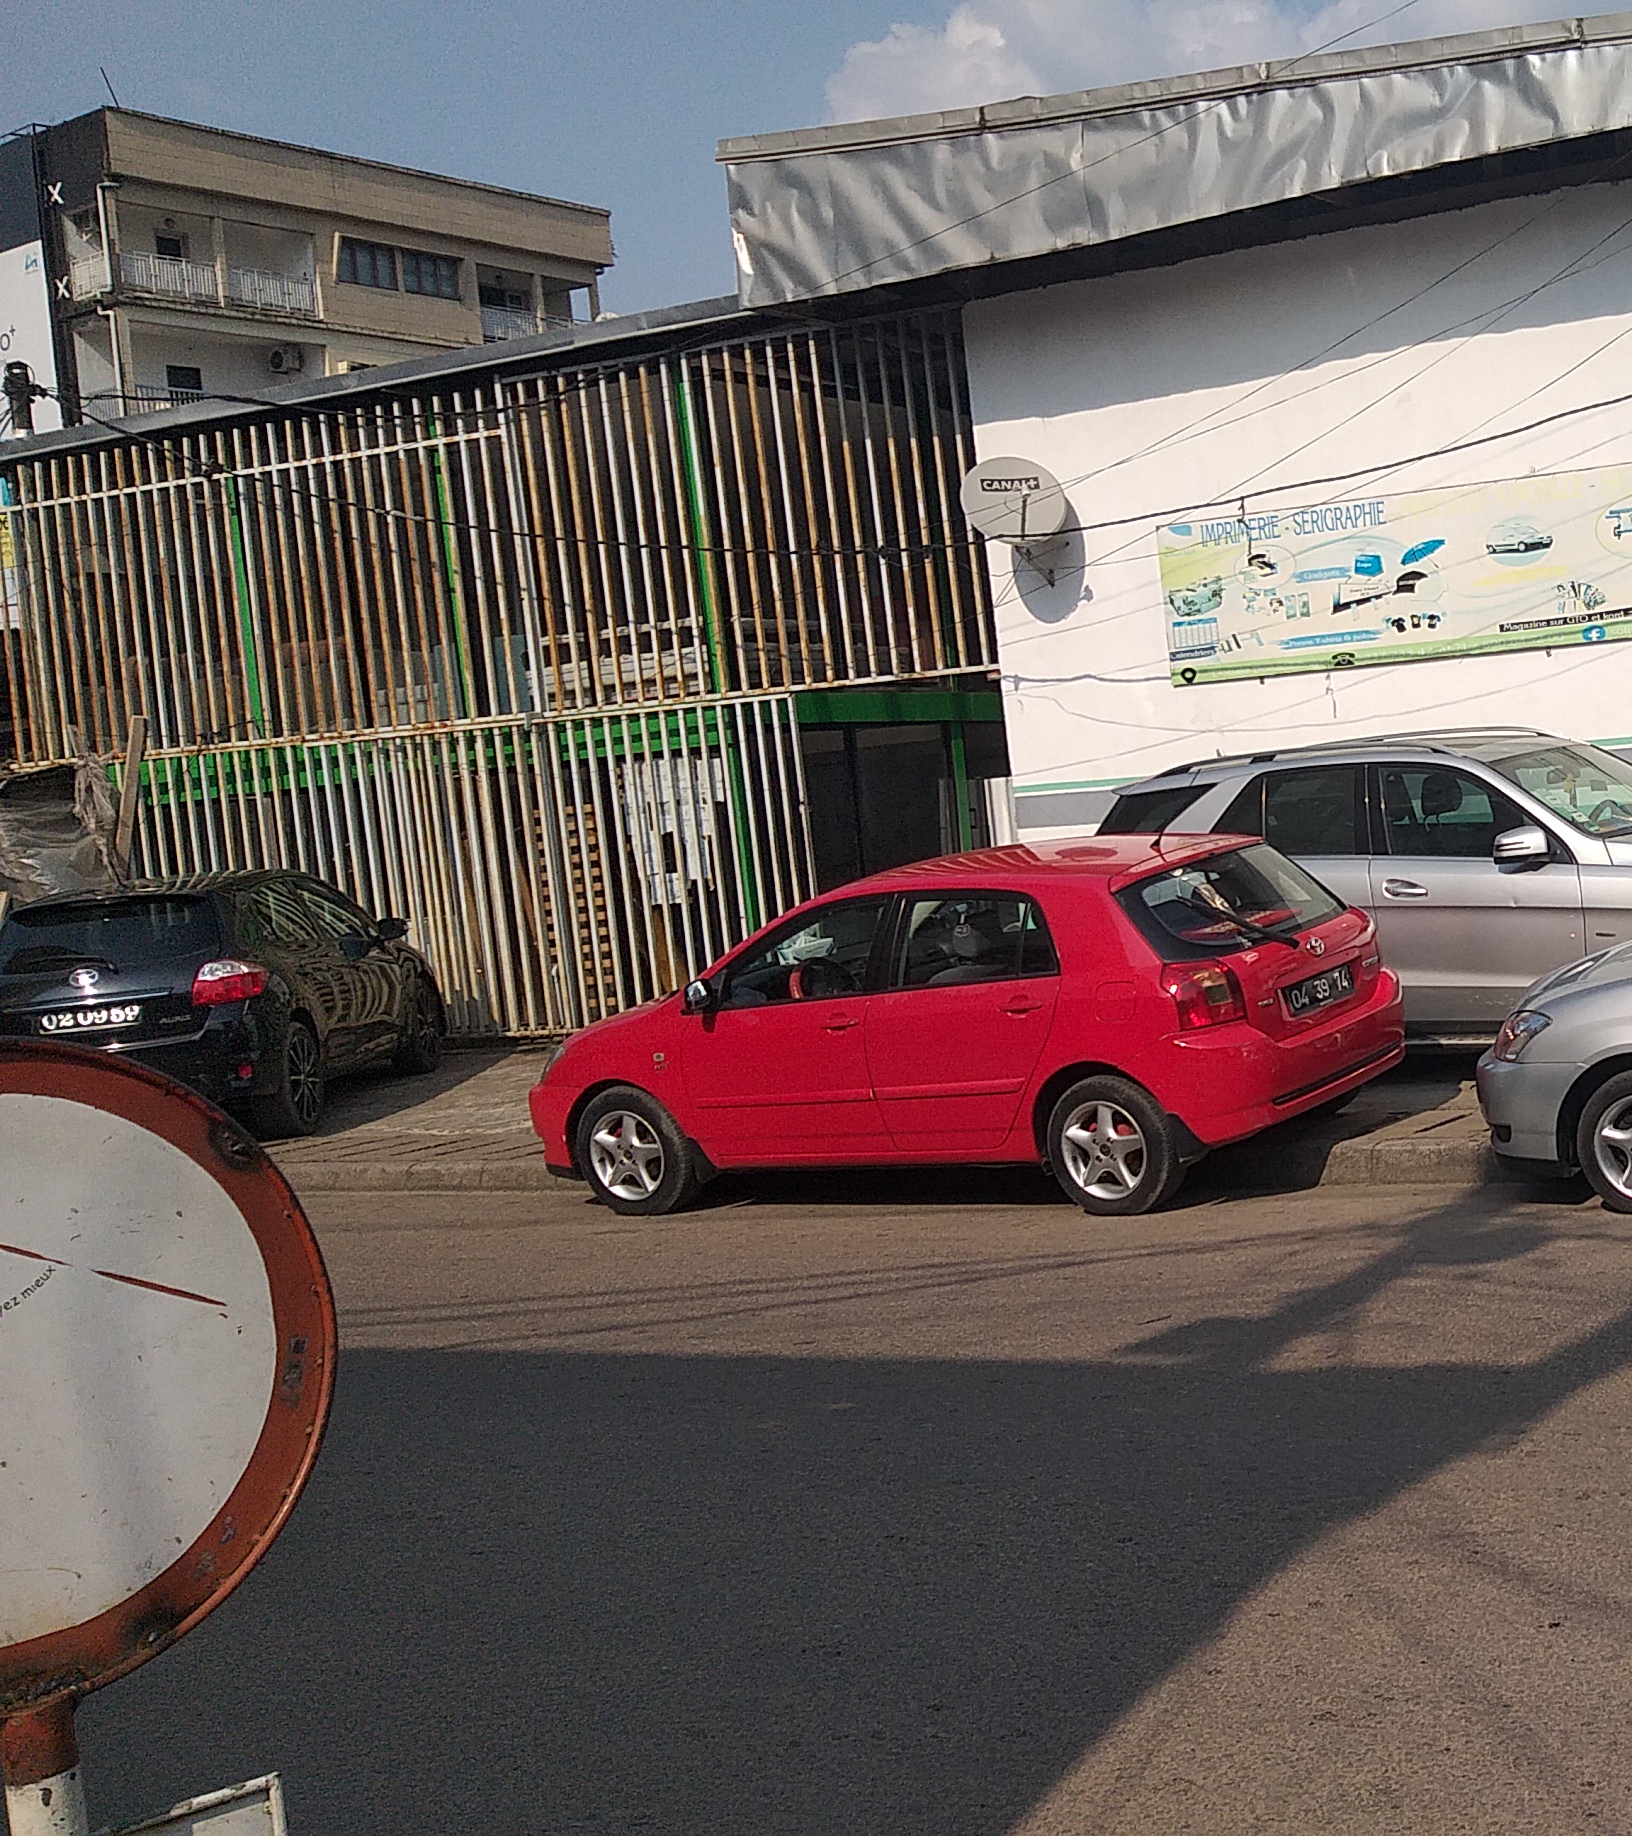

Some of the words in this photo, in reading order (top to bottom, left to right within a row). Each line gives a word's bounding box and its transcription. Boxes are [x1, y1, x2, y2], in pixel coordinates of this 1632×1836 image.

[1200, 515, 1281, 547] IMPRIMERIE
[1292, 501, 1387, 536] SERIGRAPHIE
[1303, 570, 1341, 581] Gadgets
[1503, 620, 1548, 632] Magazine
[1291, 986, 1310, 1009] 04
[1314, 979, 1330, 999] 39
[1333, 969, 1349, 991] 74
[20, 1265, 56, 1299] mieux
